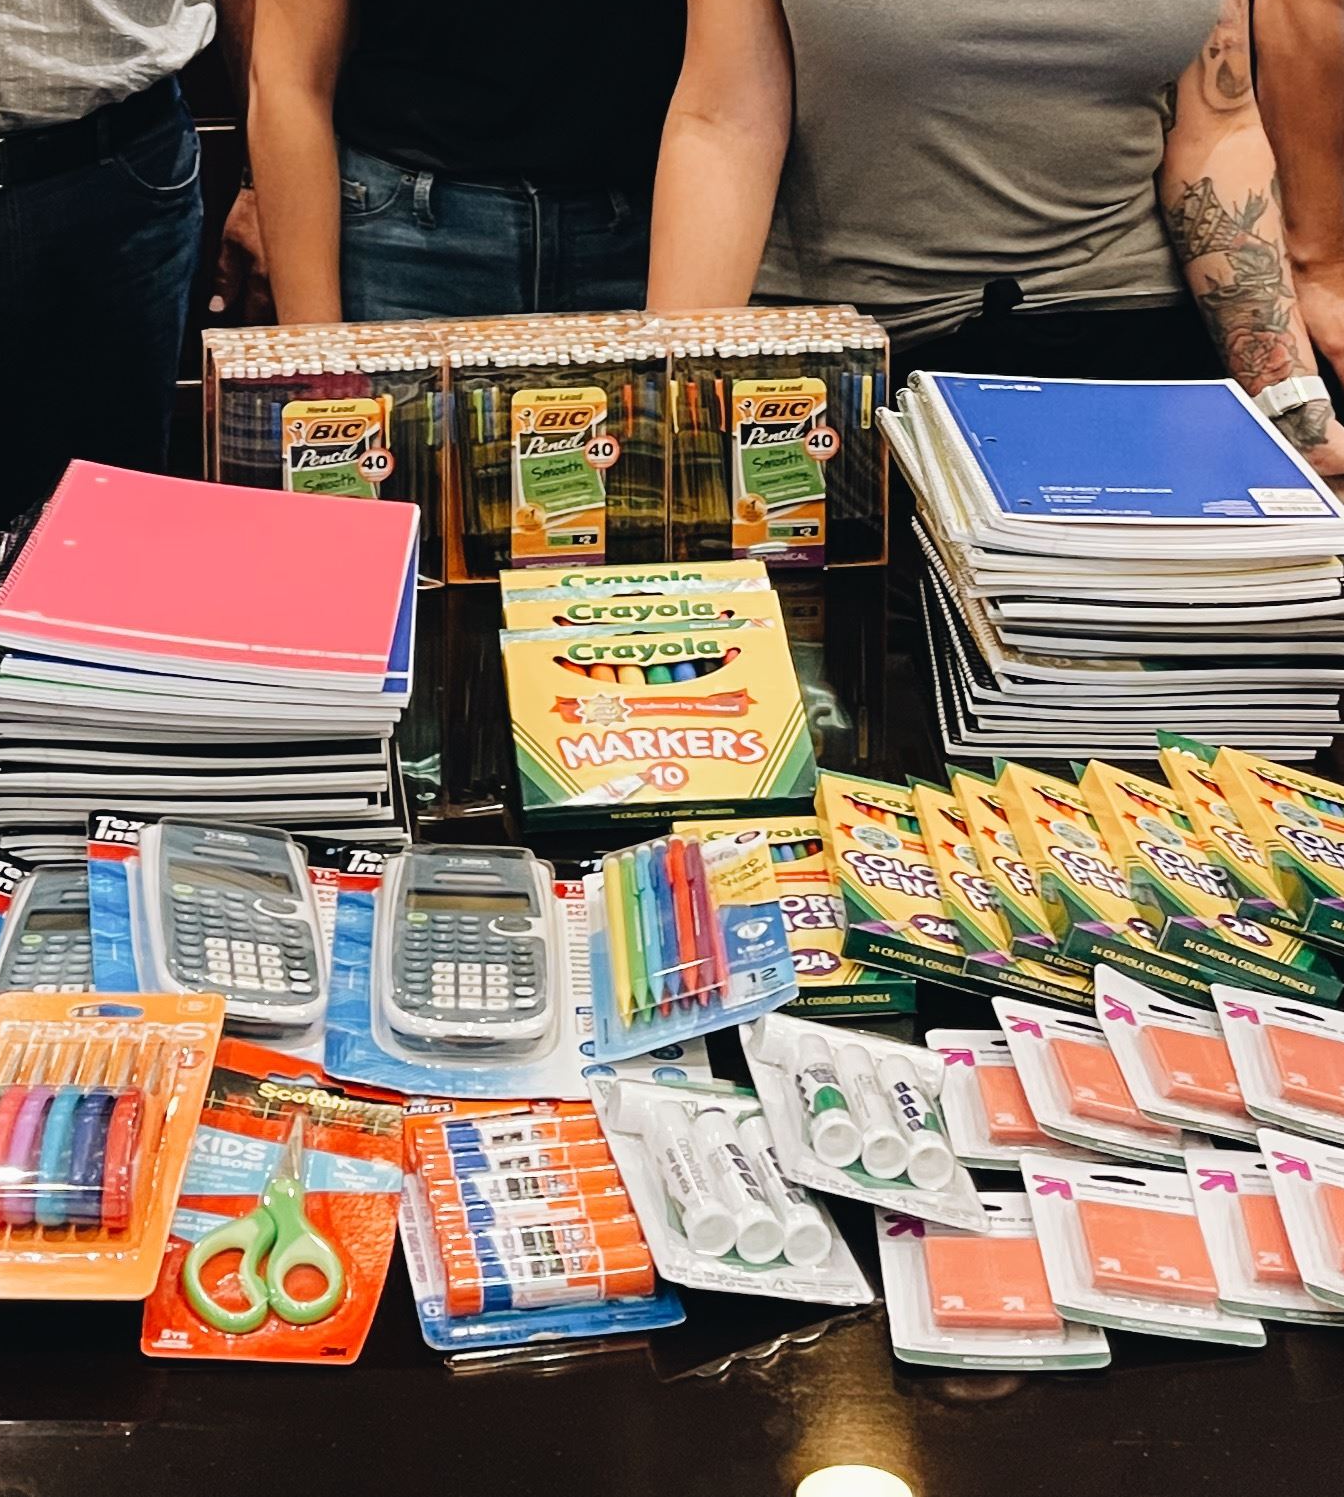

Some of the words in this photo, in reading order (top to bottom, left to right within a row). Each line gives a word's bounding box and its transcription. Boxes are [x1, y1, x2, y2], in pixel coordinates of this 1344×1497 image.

[540, 411, 589, 427] BIC
[759, 402, 809, 418] BIC
[311, 423, 363, 440] BIC
[747, 423, 805, 448] Pencil
[526, 431, 585, 458] Pencil
[588, 443, 614, 456] 40
[808, 434, 834, 448] 40
[297, 444, 358, 471] Pencil
[362, 455, 388, 470] 40
[752, 454, 804, 472] Smooth
[532, 463, 584, 481] Smooth
[304, 473, 356, 491] Smooth
[567, 600, 715, 622] Crayola
[567, 638, 722, 662] Crayola
[558, 728, 766, 770] MARKERS
[651, 766, 684, 785] 10
[921, 918, 961, 939] 24
[1220, 917, 1270, 944] 24
[793, 952, 836, 970] 24
[881, 947, 925, 967] CRAYOLA
[747, 967, 776, 982] 12
[1103, 948, 1146, 970] CRAYOLA
[1147, 960, 1188, 986] COLORED
[1195, 942, 1238, 964] CRAYOLA
[1238, 957, 1279, 980] COLORED
[1280, 972, 1316, 995] PENCILS
[807, 995, 851, 1005] COLORED
[853, 993, 891, 1004] PENCILS
[258, 1082, 349, 1111] Scotch
[423, 1302, 442, 1317] 6
[320, 1347, 347, 1356] 3M
